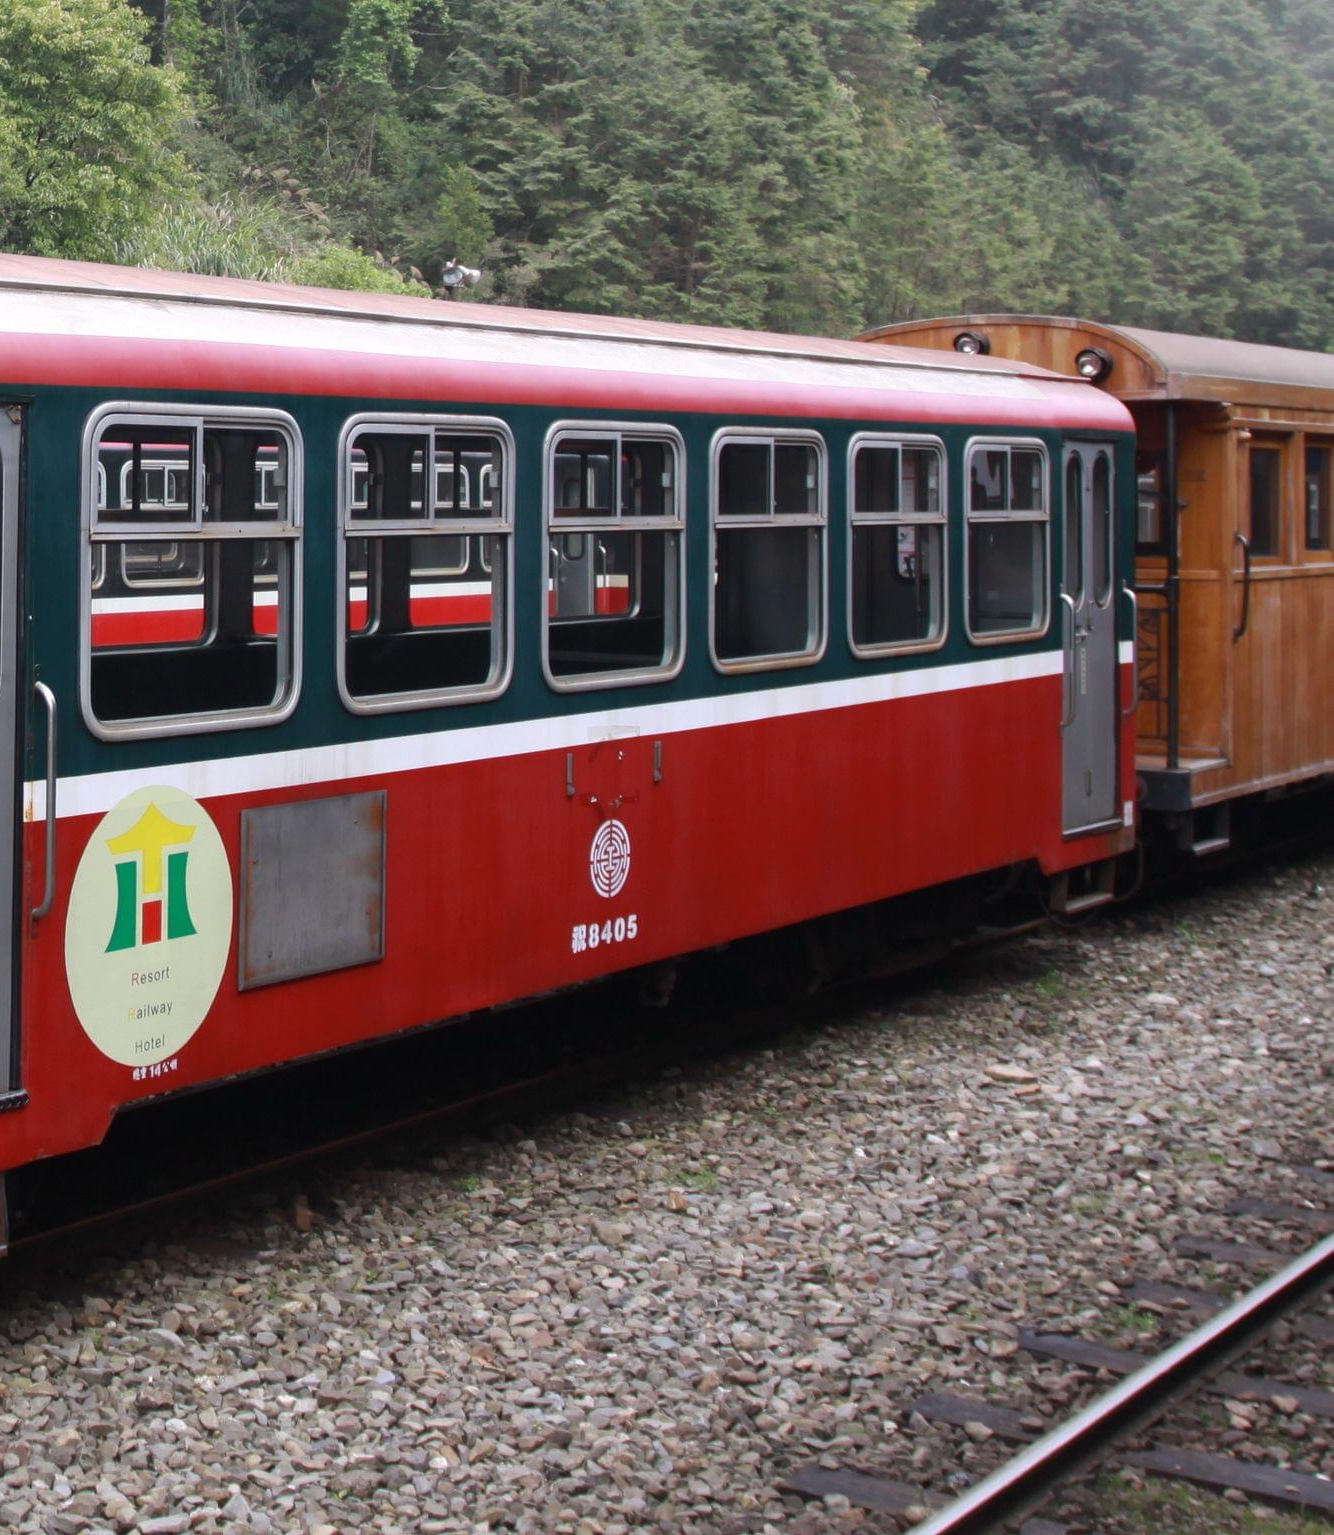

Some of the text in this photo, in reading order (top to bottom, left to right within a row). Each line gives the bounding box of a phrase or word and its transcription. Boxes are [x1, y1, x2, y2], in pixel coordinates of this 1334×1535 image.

[571, 914, 638, 954] 祝8405
[131, 966, 170, 987] Resort
[128, 1001, 173, 1021] Railway
[135, 1033, 165, 1054] Hotel
